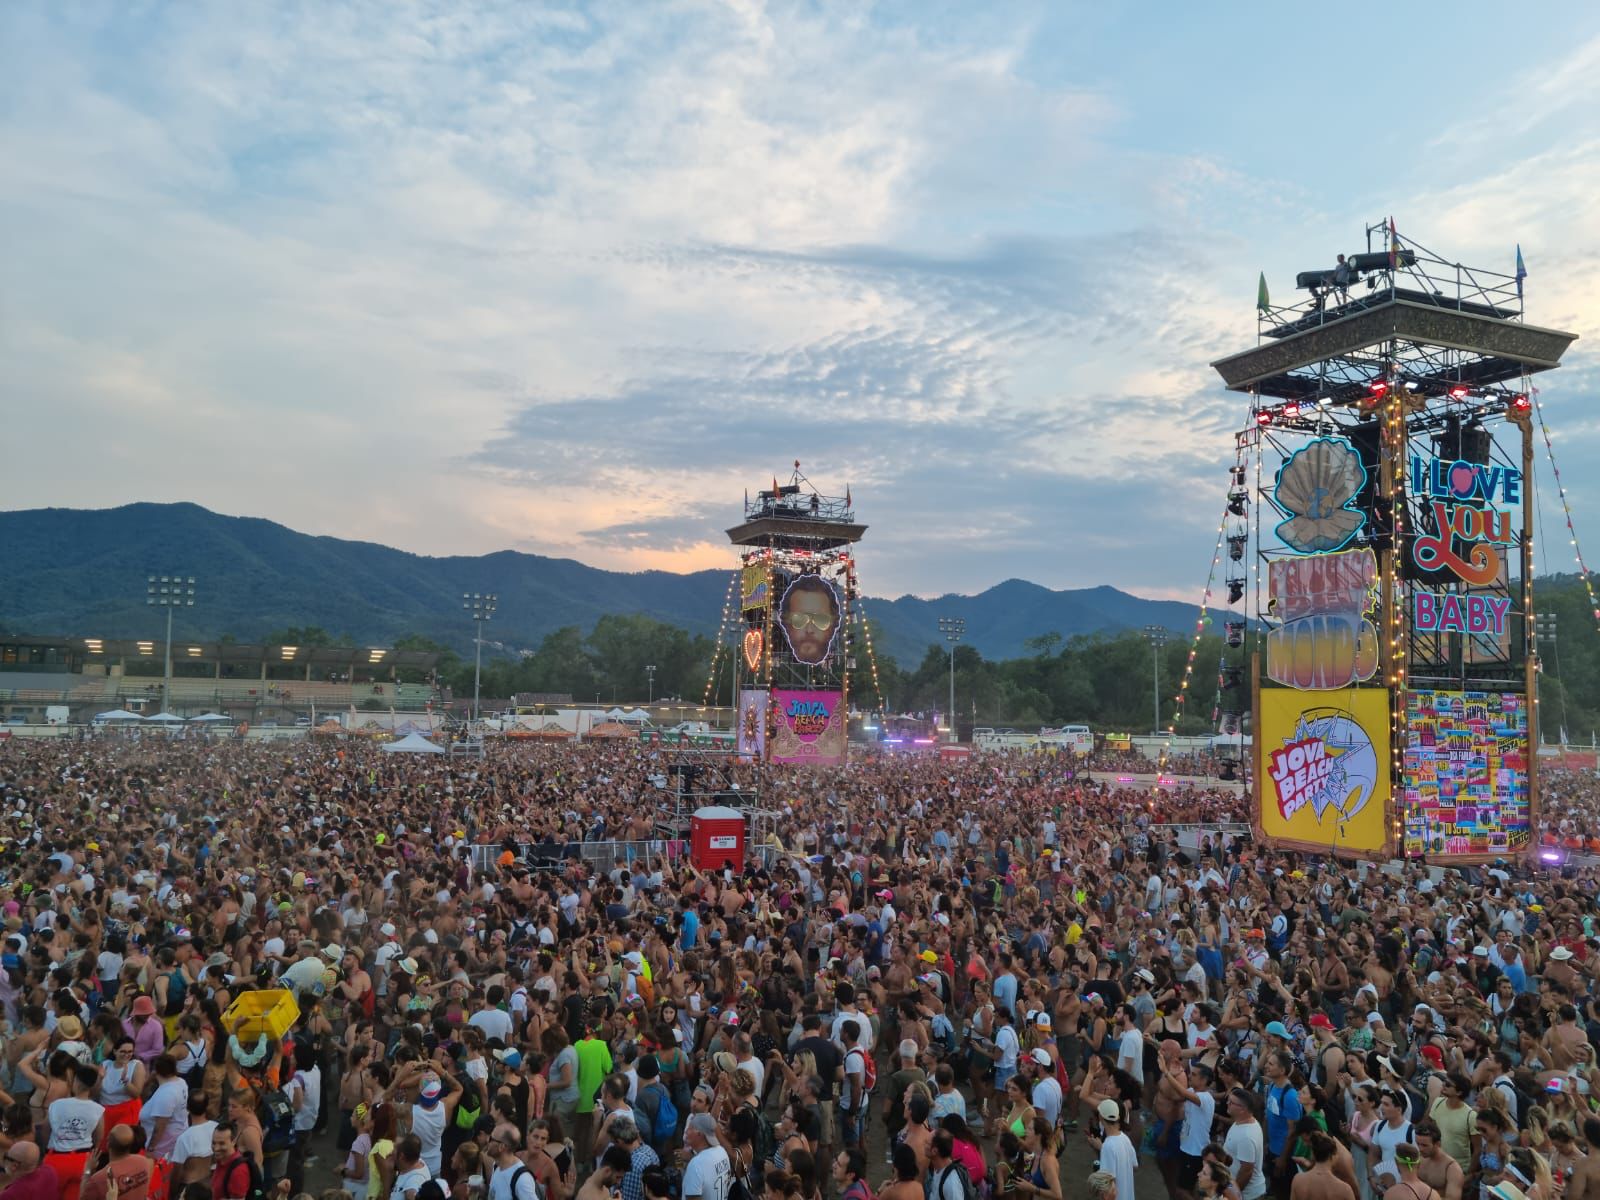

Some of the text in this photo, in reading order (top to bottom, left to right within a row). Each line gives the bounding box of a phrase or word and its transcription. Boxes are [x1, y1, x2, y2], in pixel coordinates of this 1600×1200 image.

[1411, 456, 1520, 505] I LOVE
[1415, 592, 1511, 635] BABY
[786, 699, 829, 718] JOVA
[1272, 742, 1325, 782] JOVA
[1279, 757, 1335, 802] BEACH
[1283, 774, 1330, 821] PARTY
